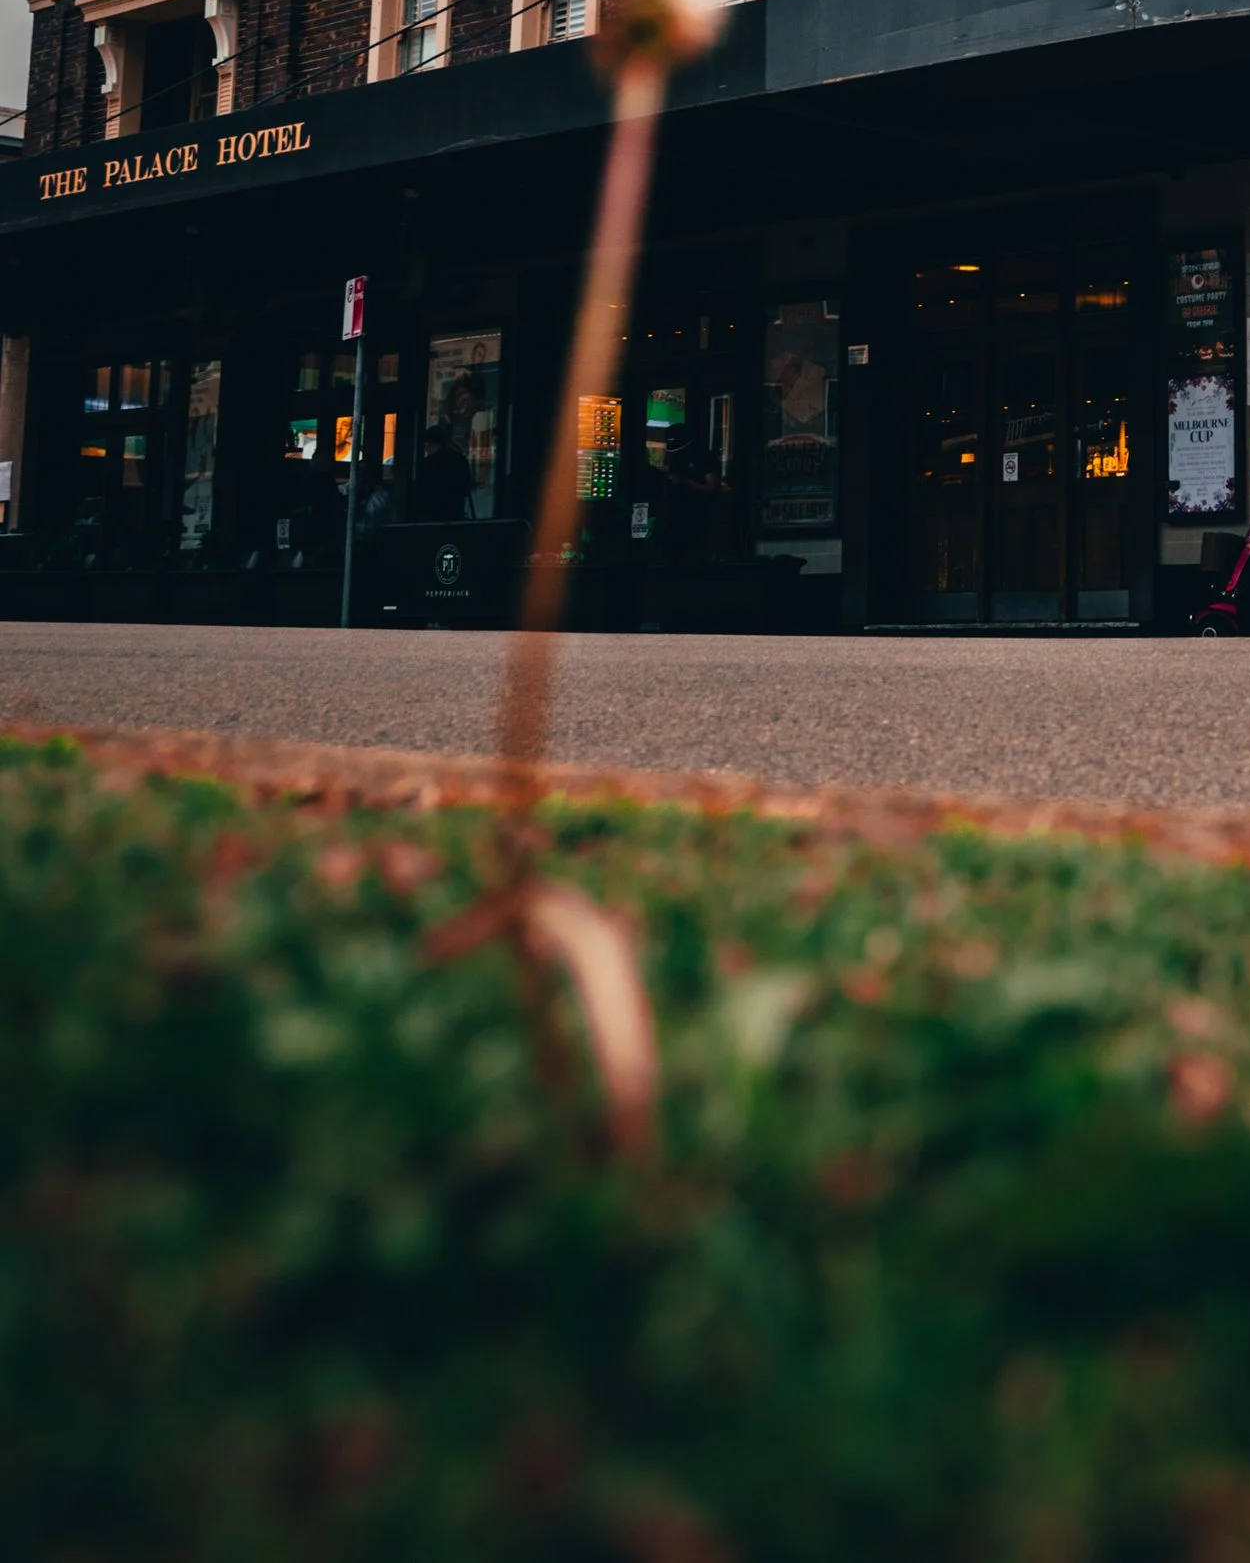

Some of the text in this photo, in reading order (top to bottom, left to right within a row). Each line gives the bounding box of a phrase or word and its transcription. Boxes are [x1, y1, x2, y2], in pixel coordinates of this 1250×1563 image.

[39, 122, 311, 200] THE PALACE HOTEL
[1176, 291, 1227, 305] COSTUME PARTY
[1173, 417, 1231, 432] MELBOURNE
[1190, 429, 1214, 444] CUP
[425, 589, 471, 598] PEPPERJACK
